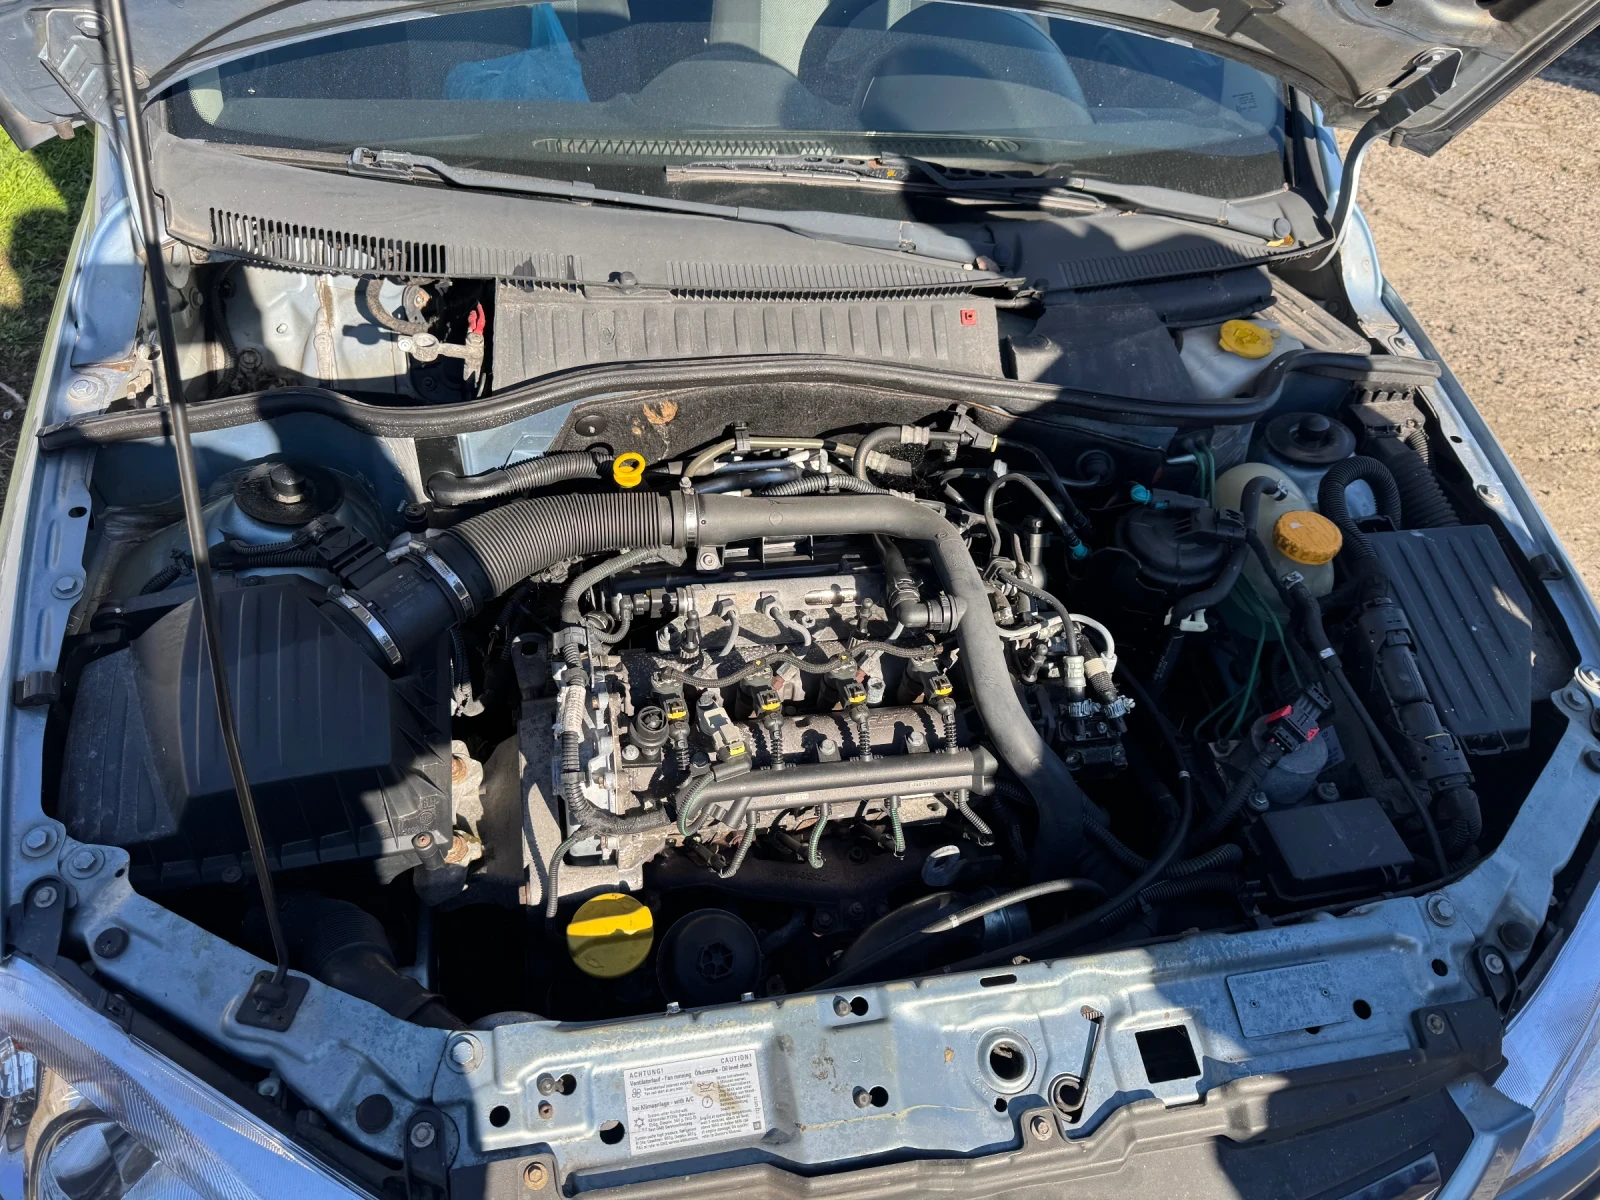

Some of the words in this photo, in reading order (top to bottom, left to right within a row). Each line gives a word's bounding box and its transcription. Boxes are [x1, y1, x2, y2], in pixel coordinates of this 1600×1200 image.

[720, 1053, 752, 1063] CAUTION!
[629, 1068, 664, 1079] ACHTUNG!
[685, 1096, 694, 1104] A/C
